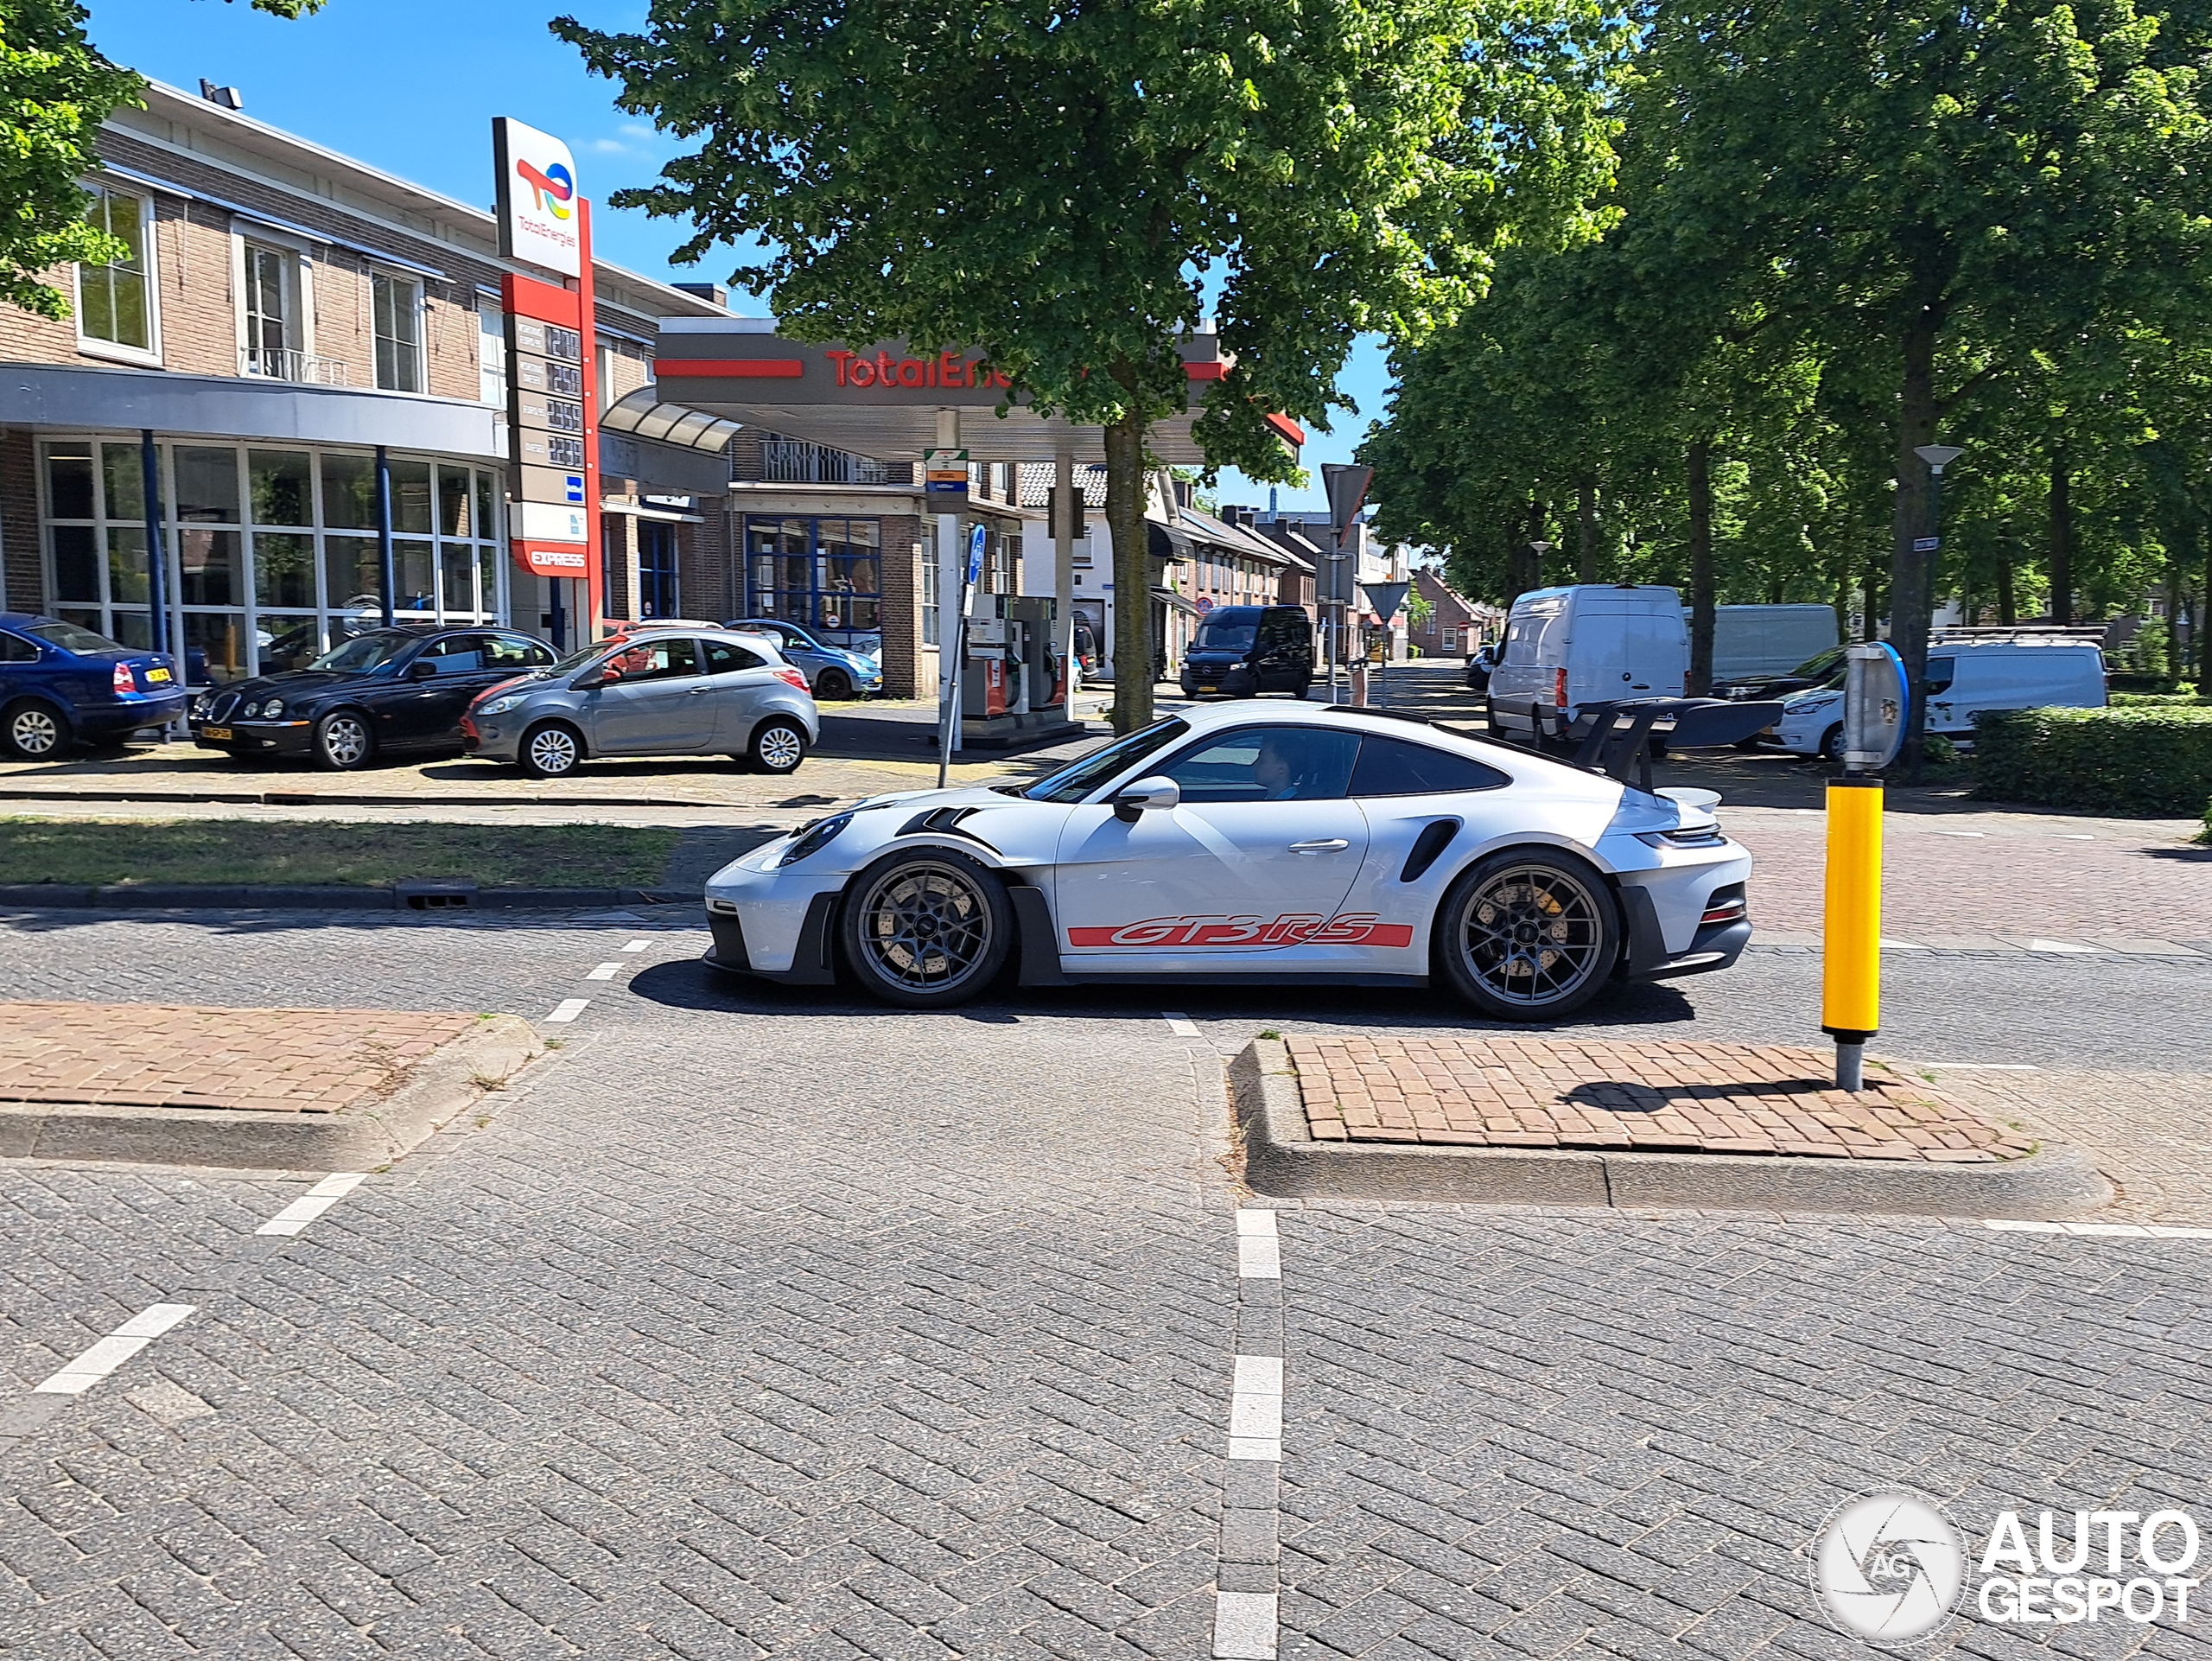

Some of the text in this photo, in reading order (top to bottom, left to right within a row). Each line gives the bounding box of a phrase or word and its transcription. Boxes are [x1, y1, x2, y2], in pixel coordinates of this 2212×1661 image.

[518, 214, 575, 248] TotalEnergies
[826, 349, 1089, 388] TotalEn
[531, 551, 586, 567] EXPRESS
